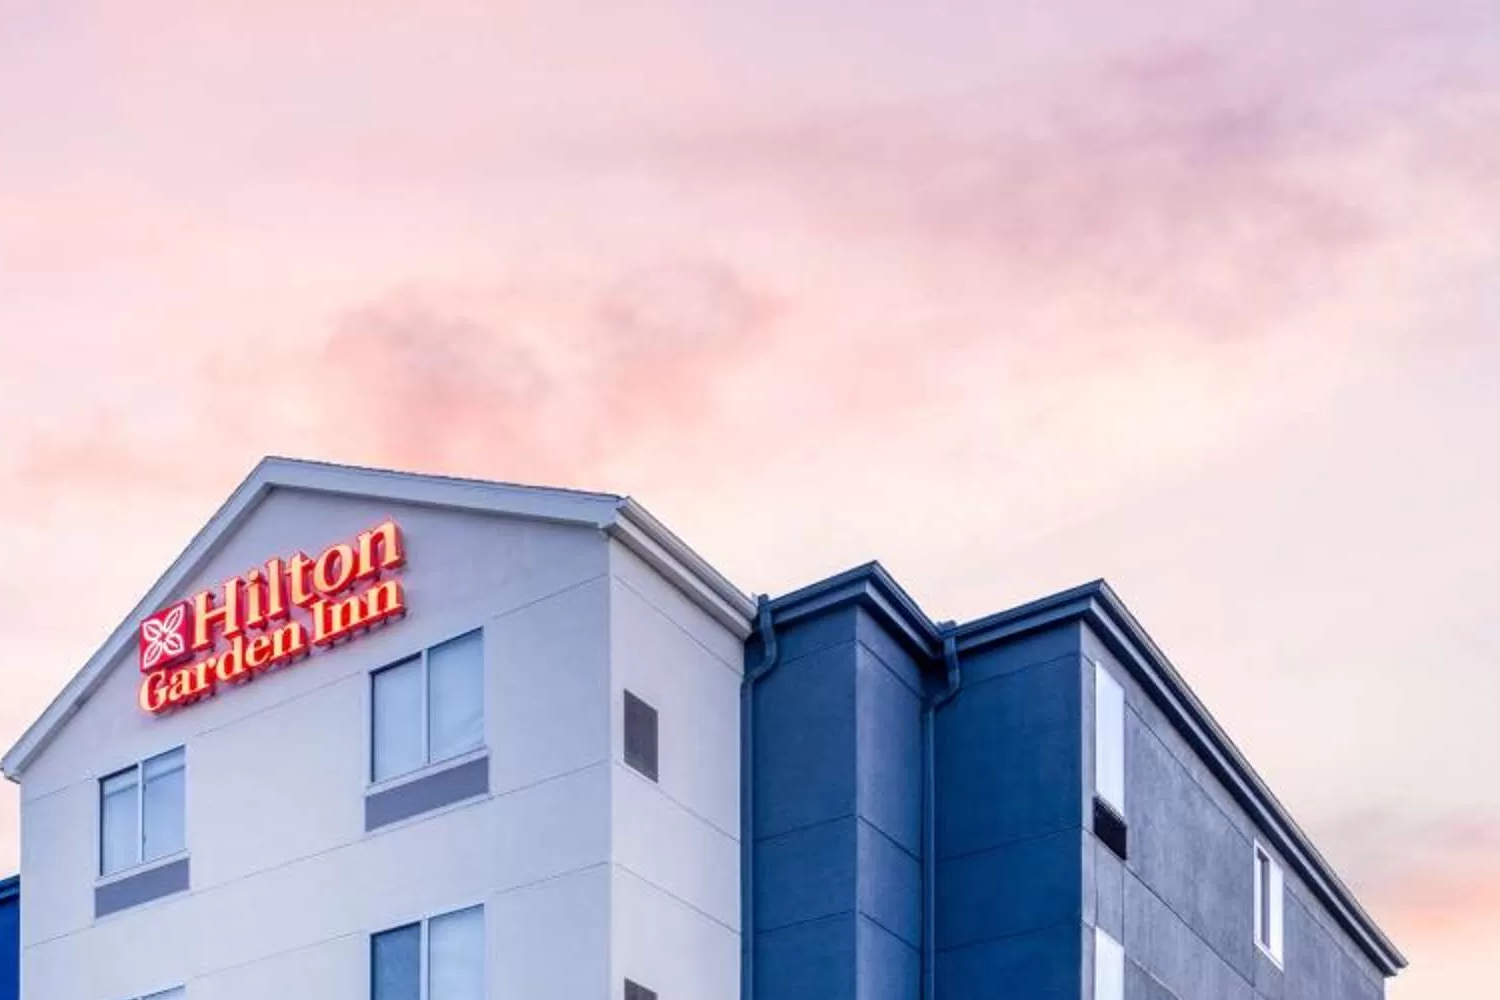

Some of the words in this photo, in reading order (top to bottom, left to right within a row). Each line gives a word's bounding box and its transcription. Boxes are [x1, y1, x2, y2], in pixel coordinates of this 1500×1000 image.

[139, 619, 308, 714] Garden
[310, 579, 405, 645] Inn
[191, 519, 405, 651] Hilton
